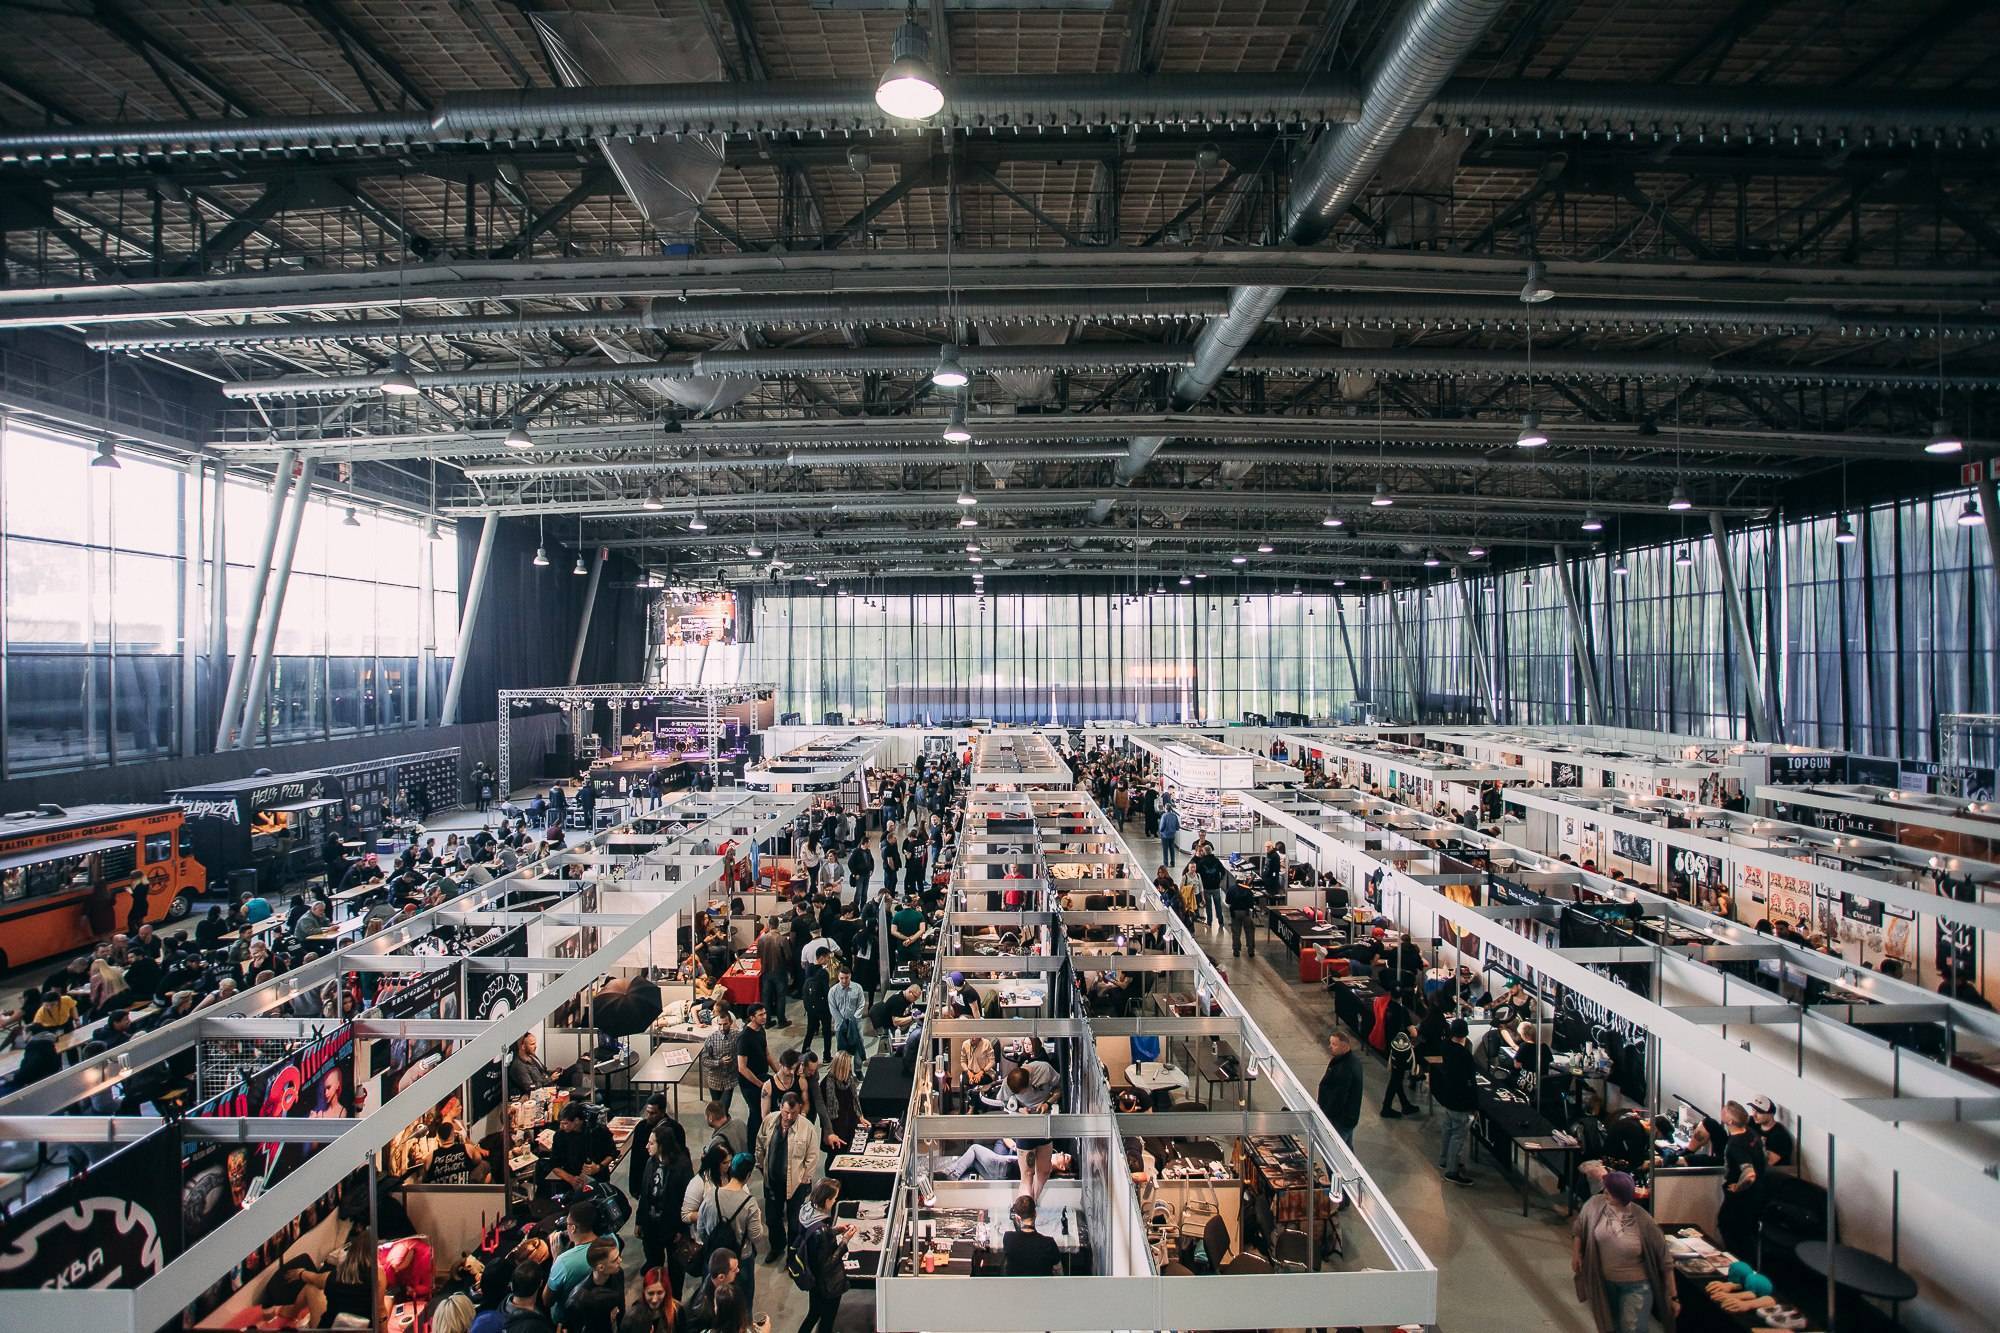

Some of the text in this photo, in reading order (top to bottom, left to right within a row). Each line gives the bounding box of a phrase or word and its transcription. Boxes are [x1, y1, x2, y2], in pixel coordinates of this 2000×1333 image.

[280, 783, 304, 801] PIZZA
[45, 832, 73, 844] FRESH
[81, 823, 119, 837] ORGANIC
[148, 815, 169, 825] TASTY
